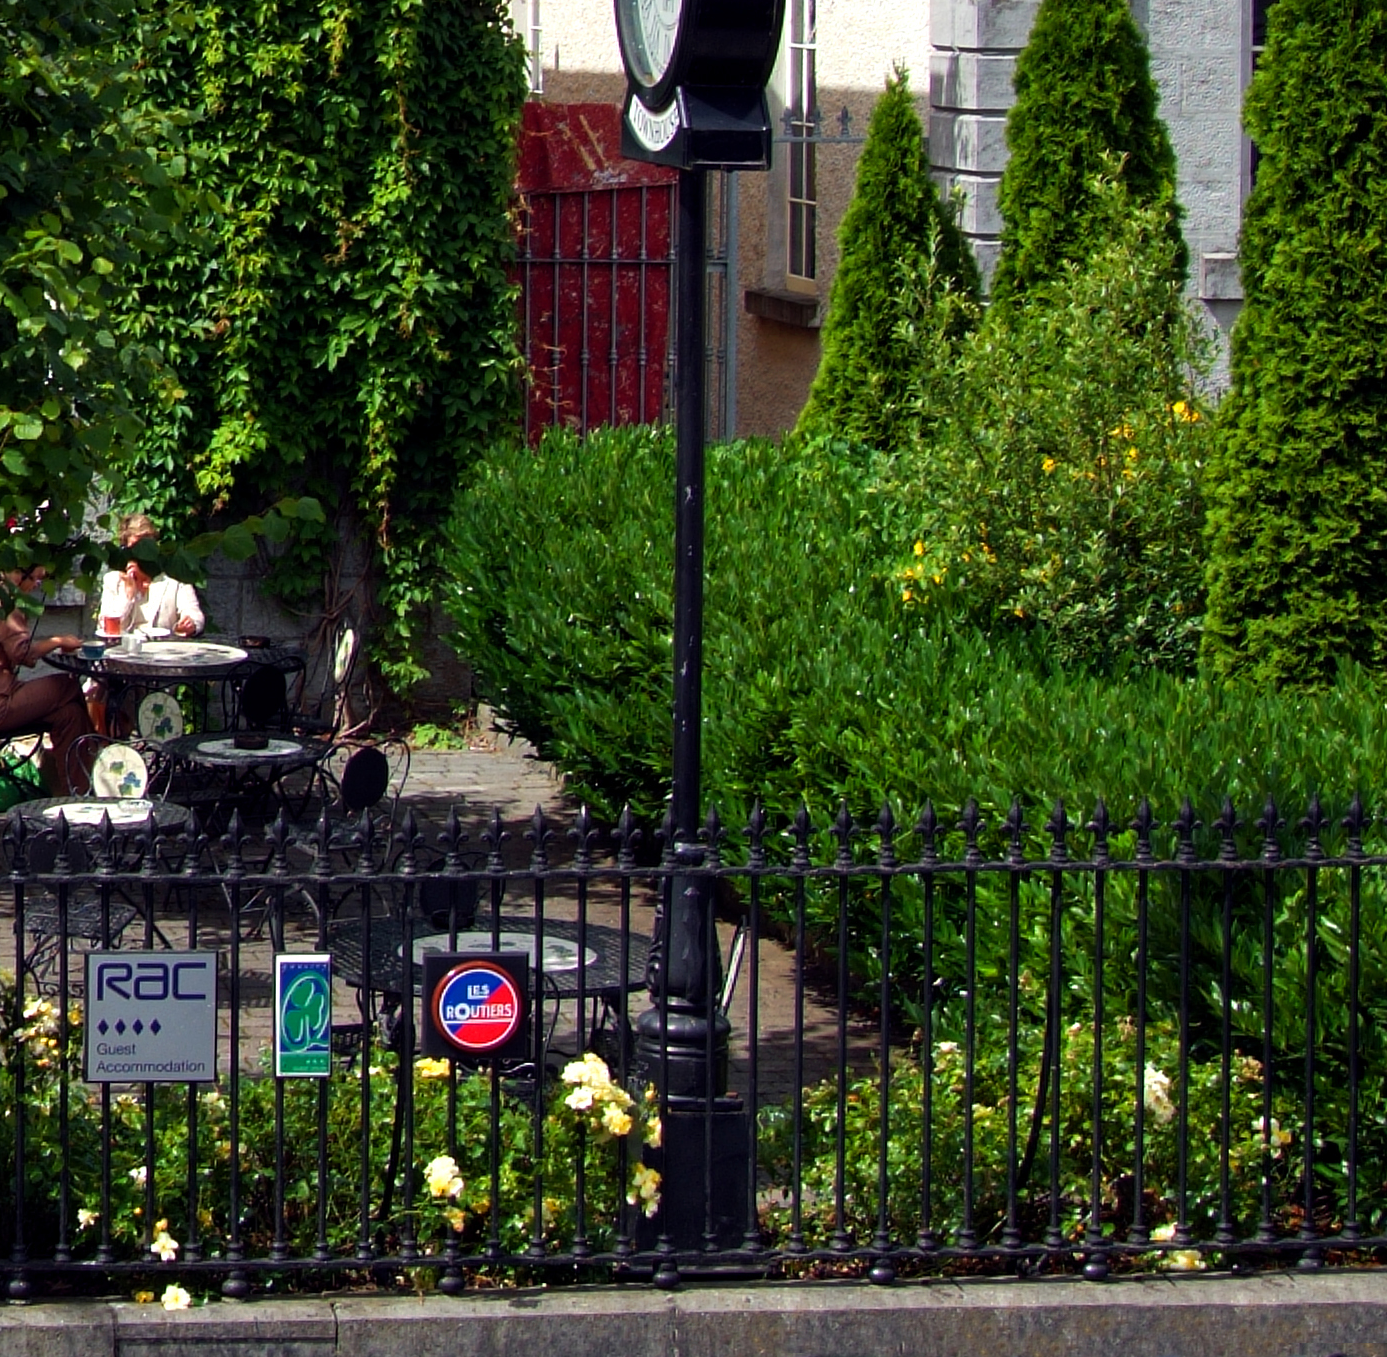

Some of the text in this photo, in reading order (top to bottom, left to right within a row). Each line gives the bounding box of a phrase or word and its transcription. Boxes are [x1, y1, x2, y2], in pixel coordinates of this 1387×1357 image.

[467, 984, 490, 1000] LES
[446, 1003, 512, 1021] ROUTIERS
[96, 1043, 136, 1056] Guest
[96, 1060, 205, 1073] Accommodation
